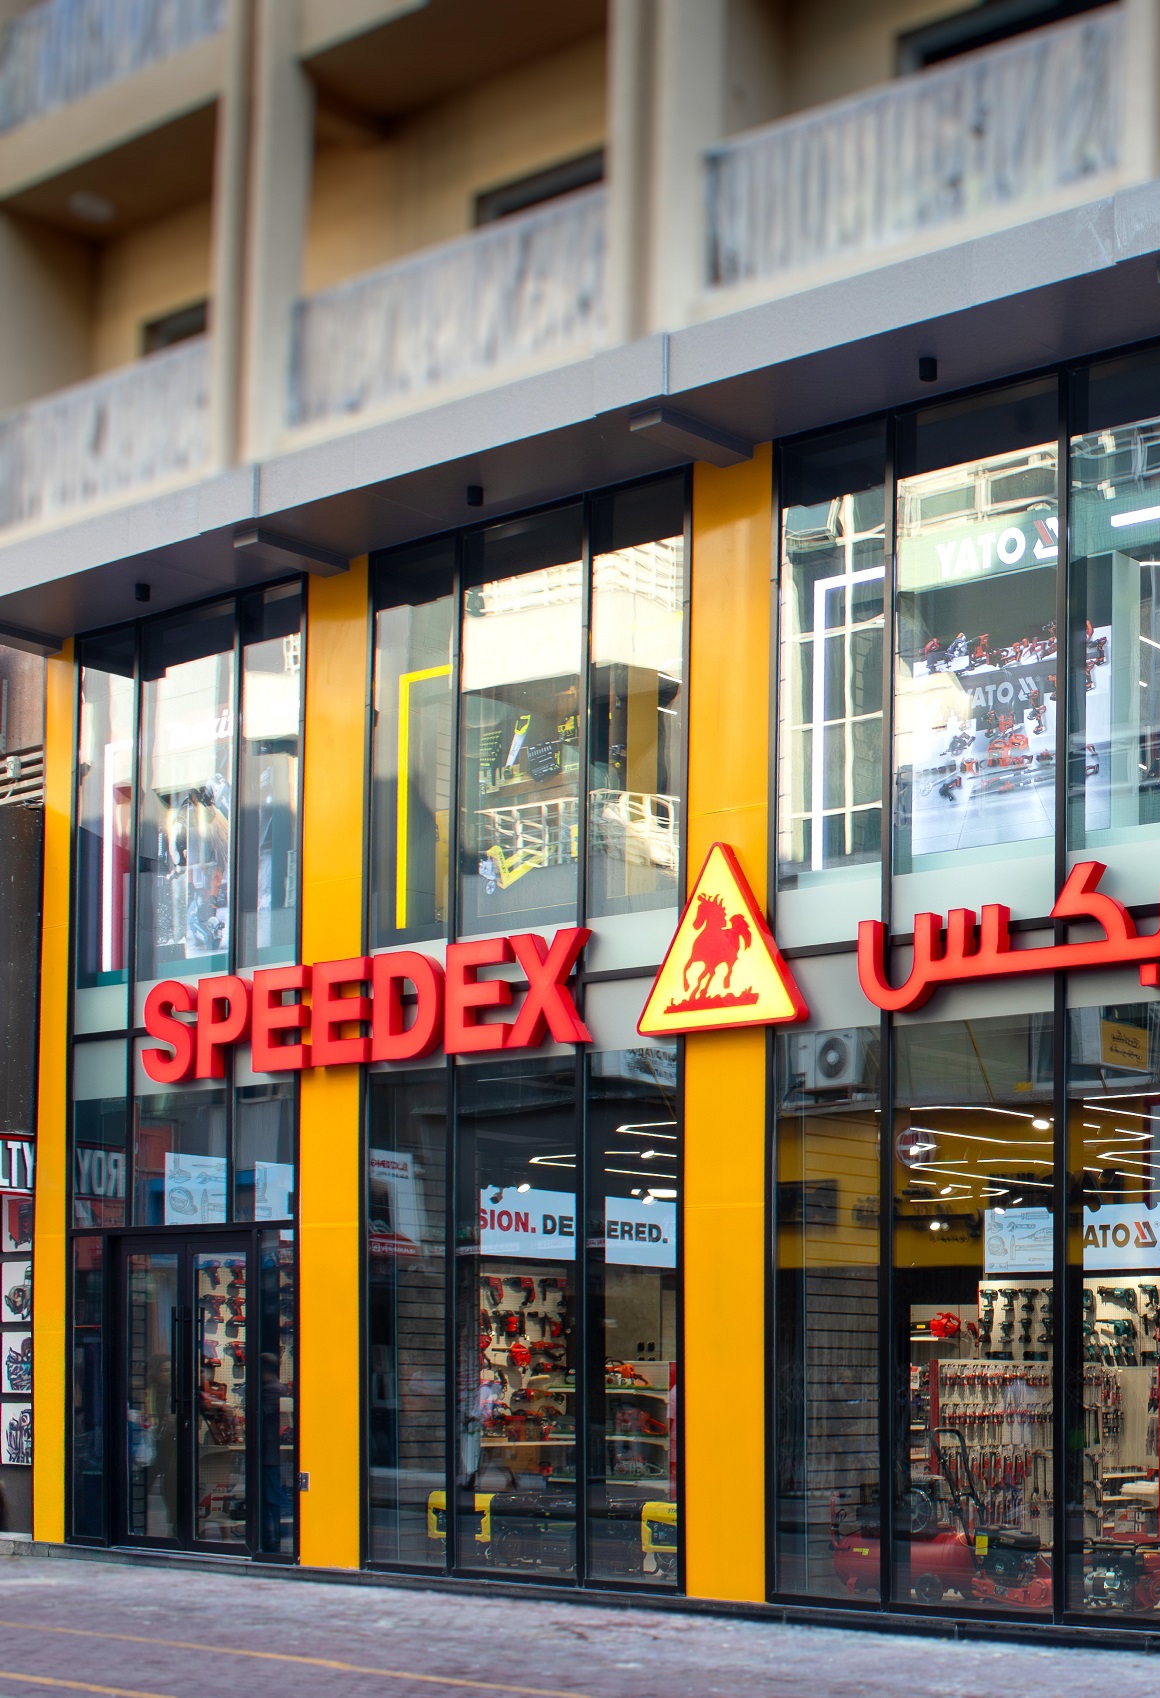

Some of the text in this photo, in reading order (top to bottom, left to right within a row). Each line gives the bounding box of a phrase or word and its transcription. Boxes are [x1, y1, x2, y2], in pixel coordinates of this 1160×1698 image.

[935, 527, 1016, 578] YATO
[142, 927, 592, 1084] SPEEDEX
[1083, 1224, 1130, 1248] ATO
